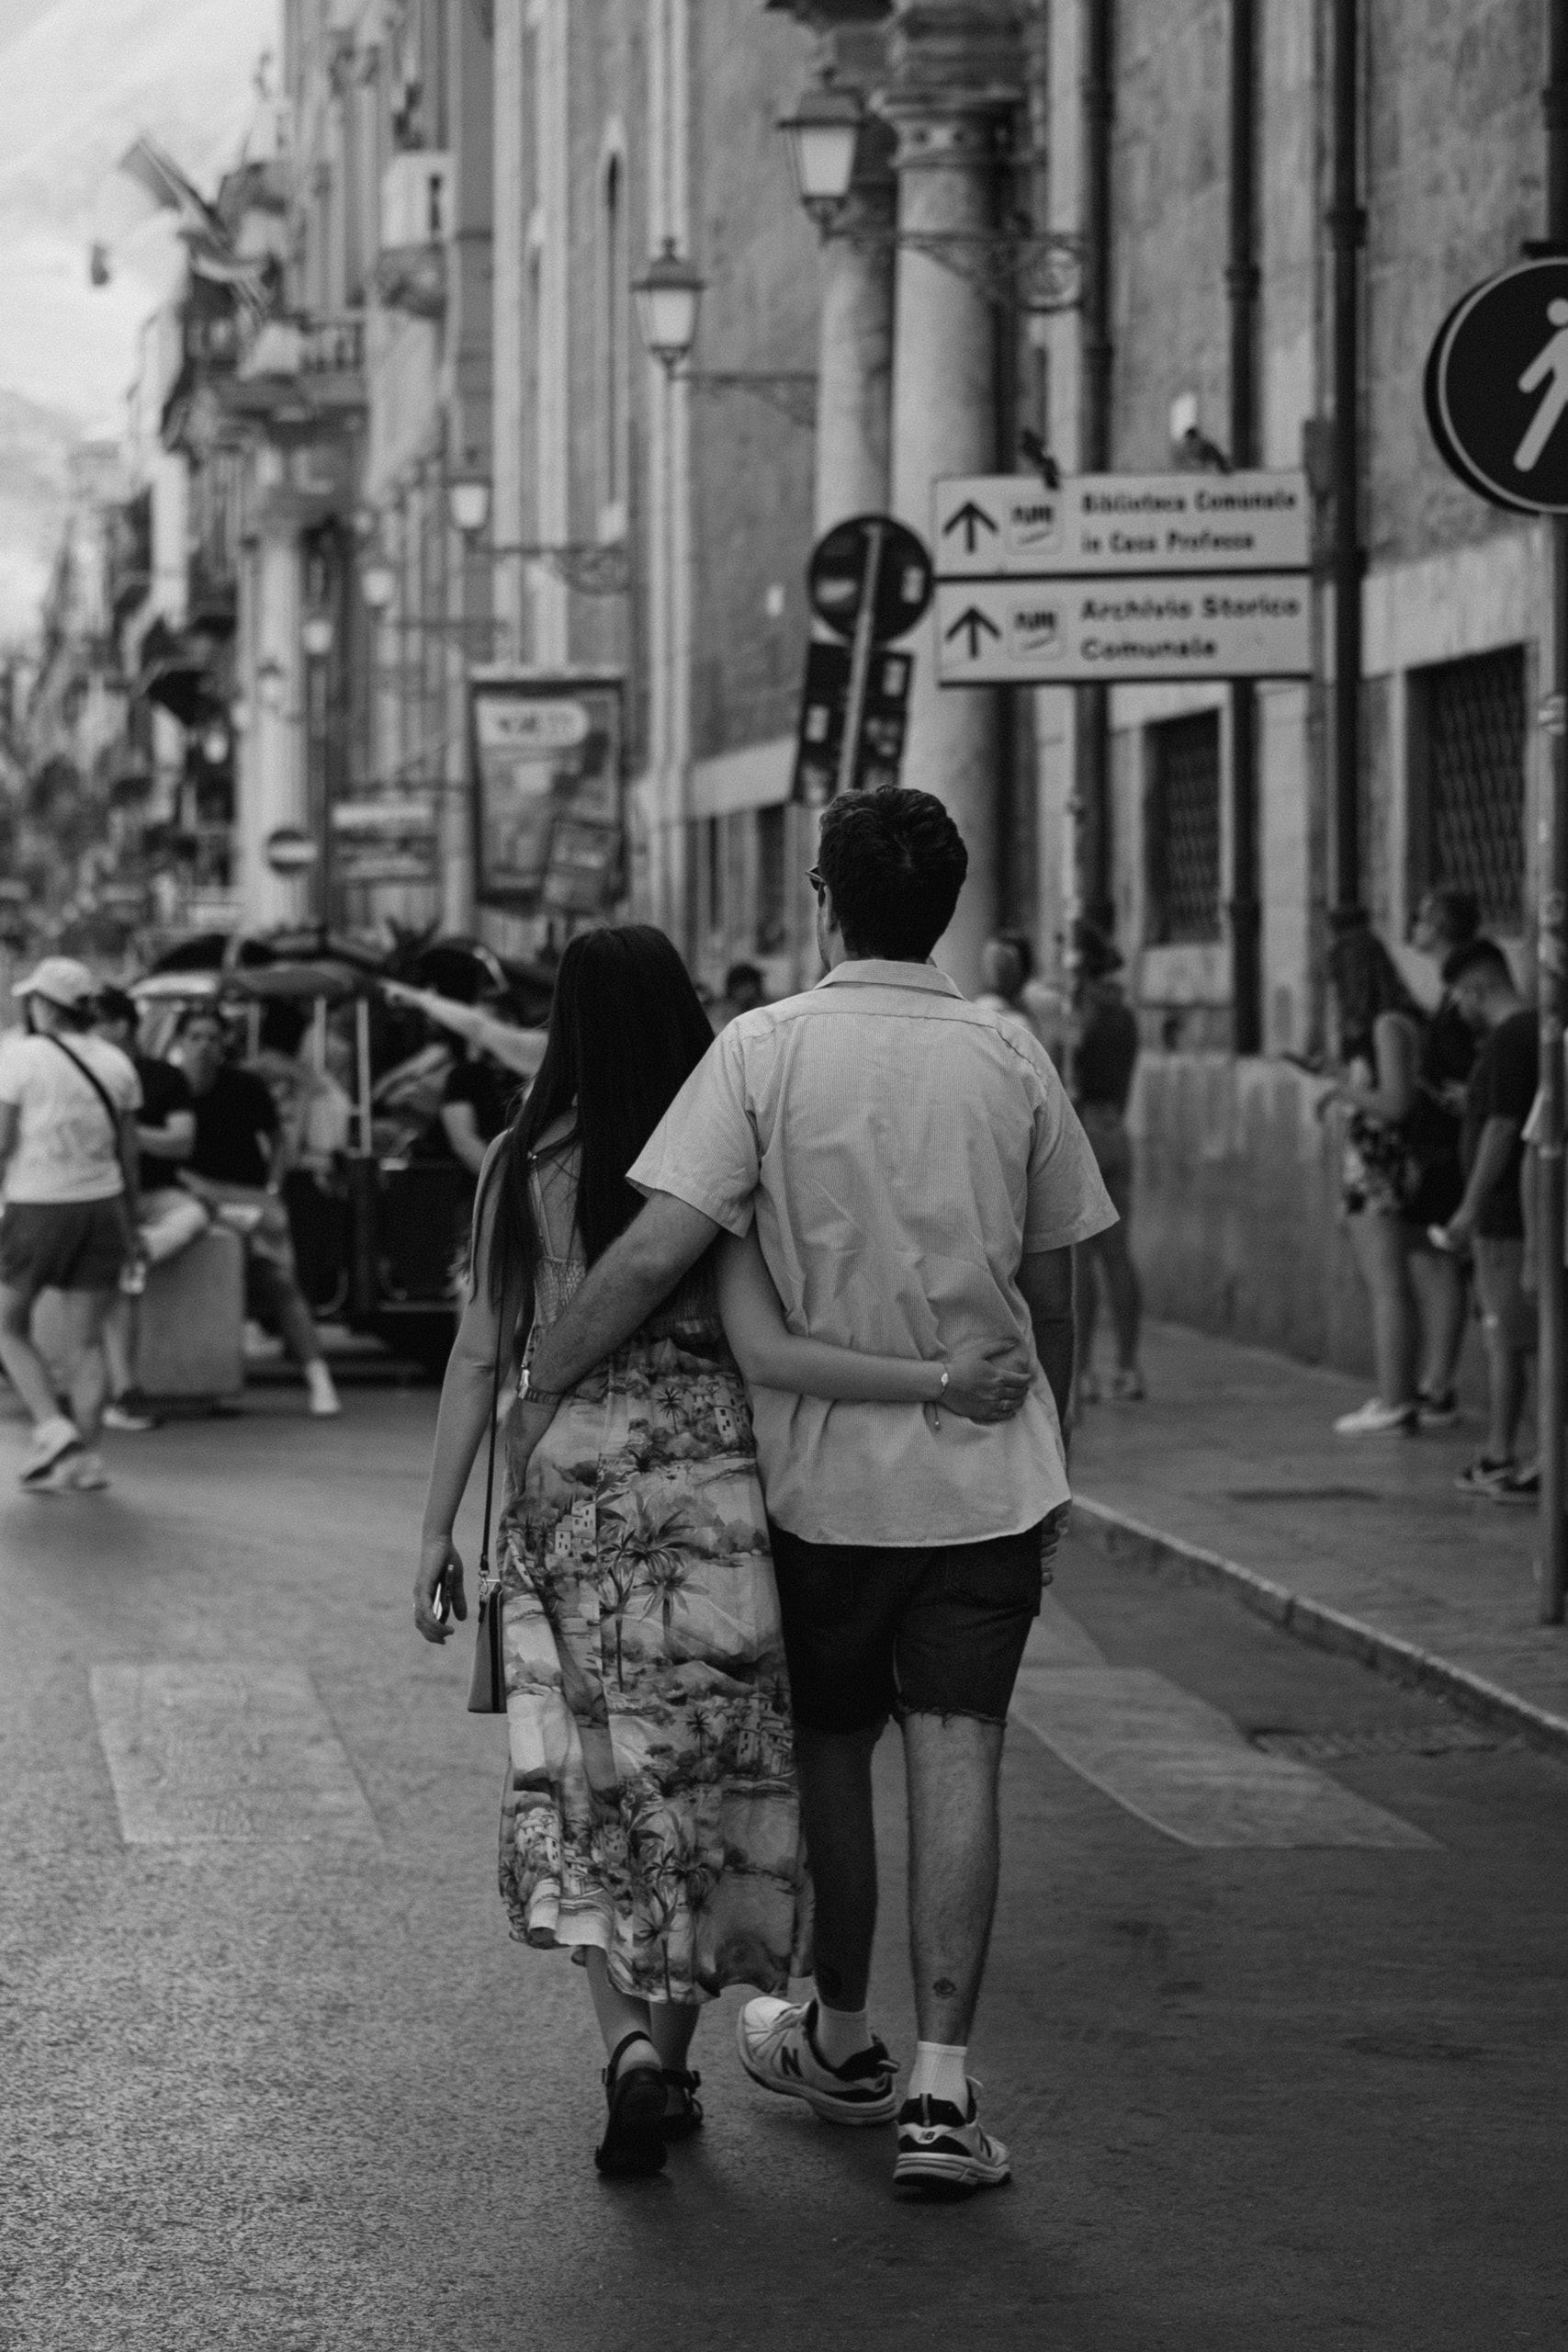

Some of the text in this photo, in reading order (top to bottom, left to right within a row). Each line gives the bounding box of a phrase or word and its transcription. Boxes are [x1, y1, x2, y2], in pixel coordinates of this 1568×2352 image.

[1195, 489, 1297, 511] Comunale
[1080, 598, 1192, 621] Archivio
[1201, 595, 1302, 618] Storico
[1080, 637, 1217, 661] Comunale
[780, 2046, 803, 2078] N
